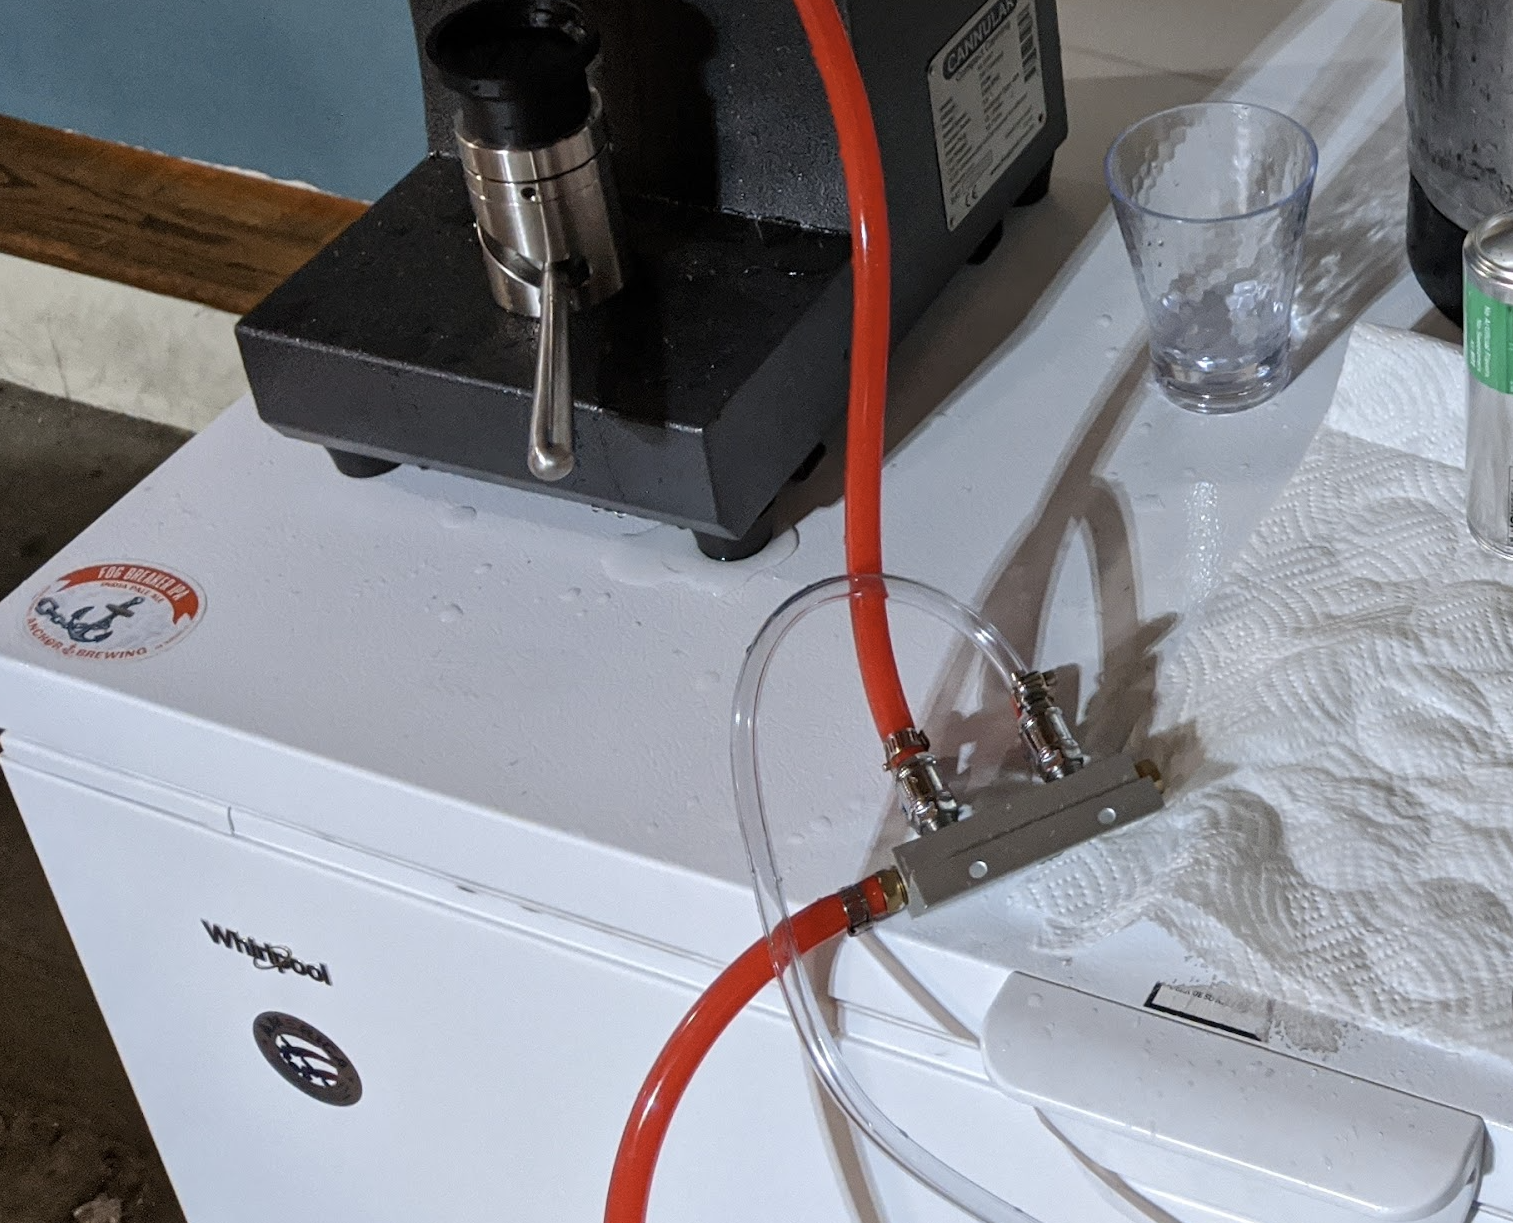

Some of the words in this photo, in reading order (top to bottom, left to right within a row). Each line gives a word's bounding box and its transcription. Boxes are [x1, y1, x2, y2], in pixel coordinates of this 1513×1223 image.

[98, 565, 125, 579] FOG
[122, 567, 177, 591] BREAKER
[165, 583, 190, 601] IPA
[27, 617, 64, 650] ANCHOR
[76, 646, 148, 659] BREWING
[200, 918, 334, 987] Whirlpool
